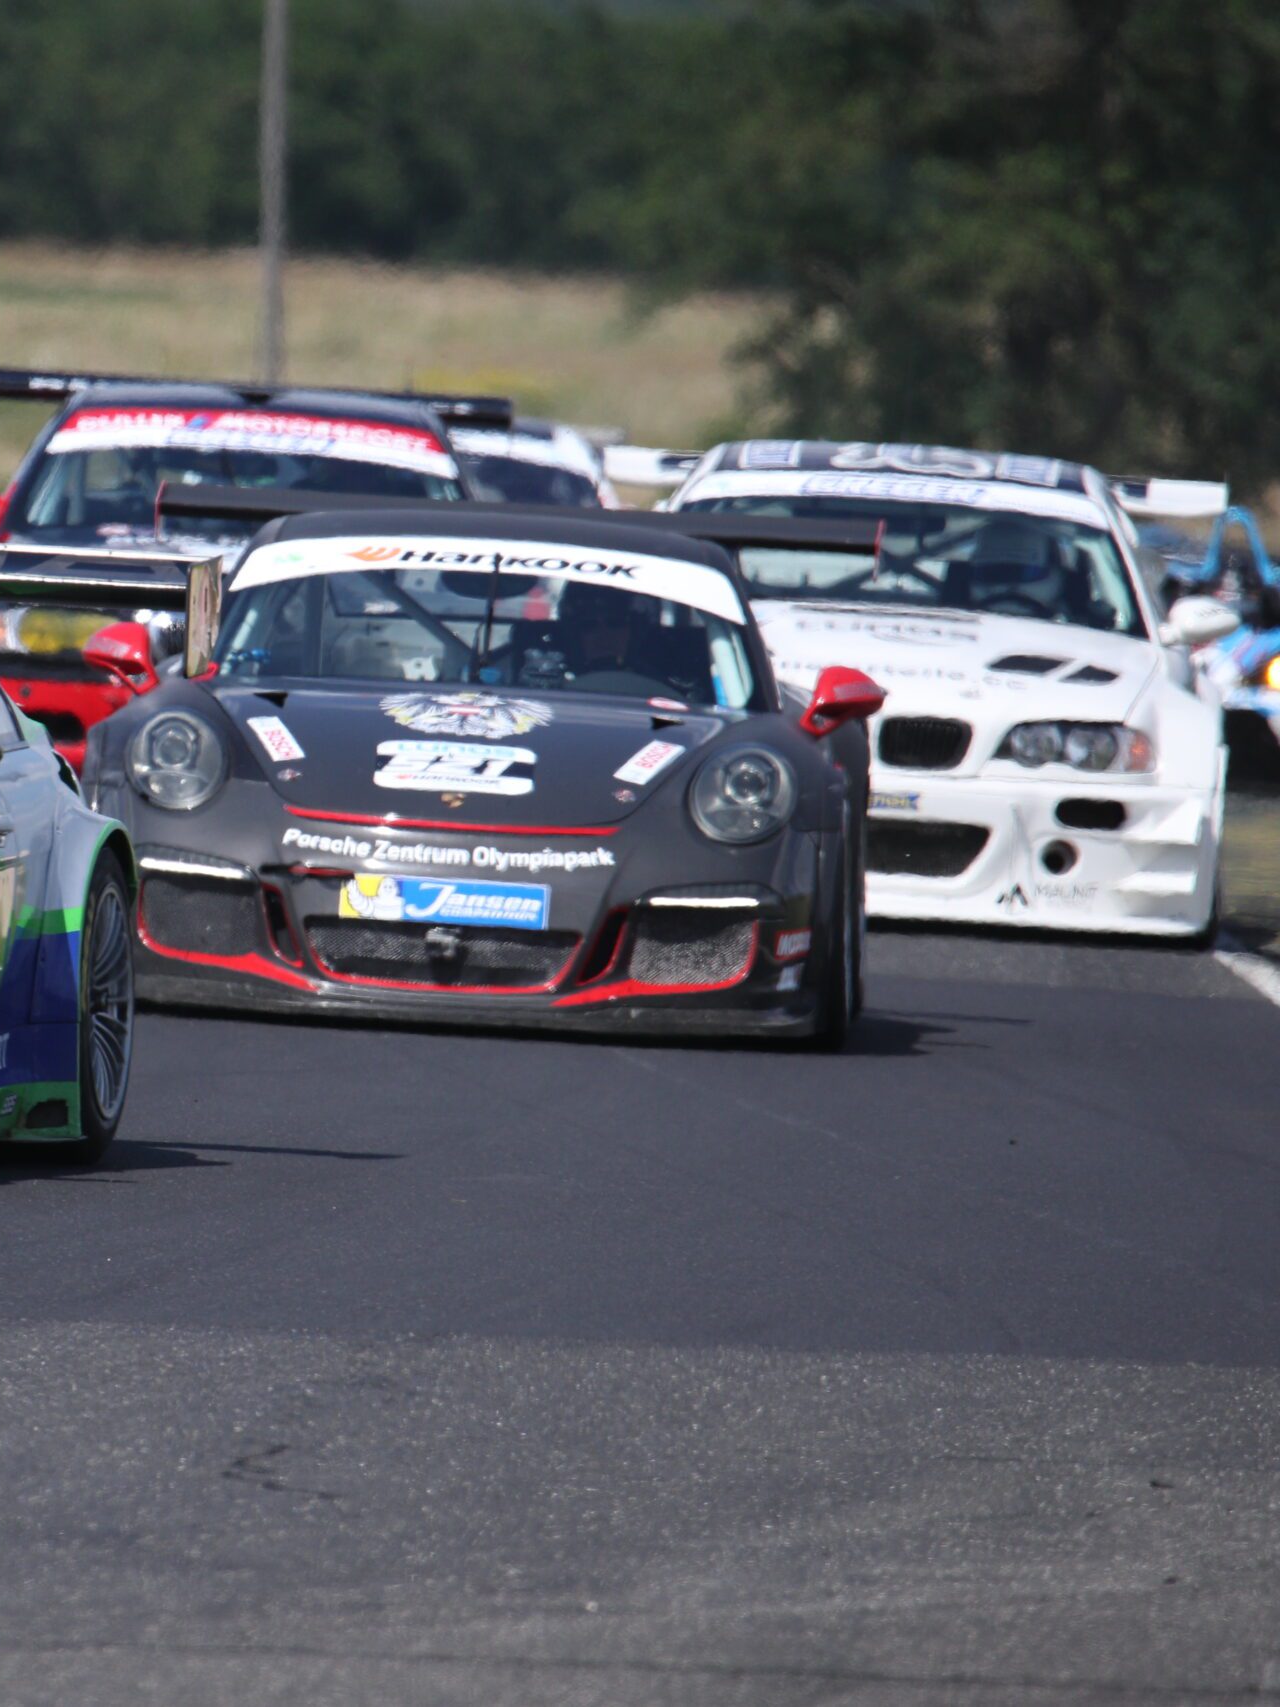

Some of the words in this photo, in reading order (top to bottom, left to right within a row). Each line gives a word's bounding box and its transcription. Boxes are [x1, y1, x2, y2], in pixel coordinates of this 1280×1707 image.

[281, 828, 371, 858] Porsche
[373, 840, 471, 867] Zentrum
[472, 845, 616, 873] Olympiapark
[405, 881, 542, 918] Jansen
